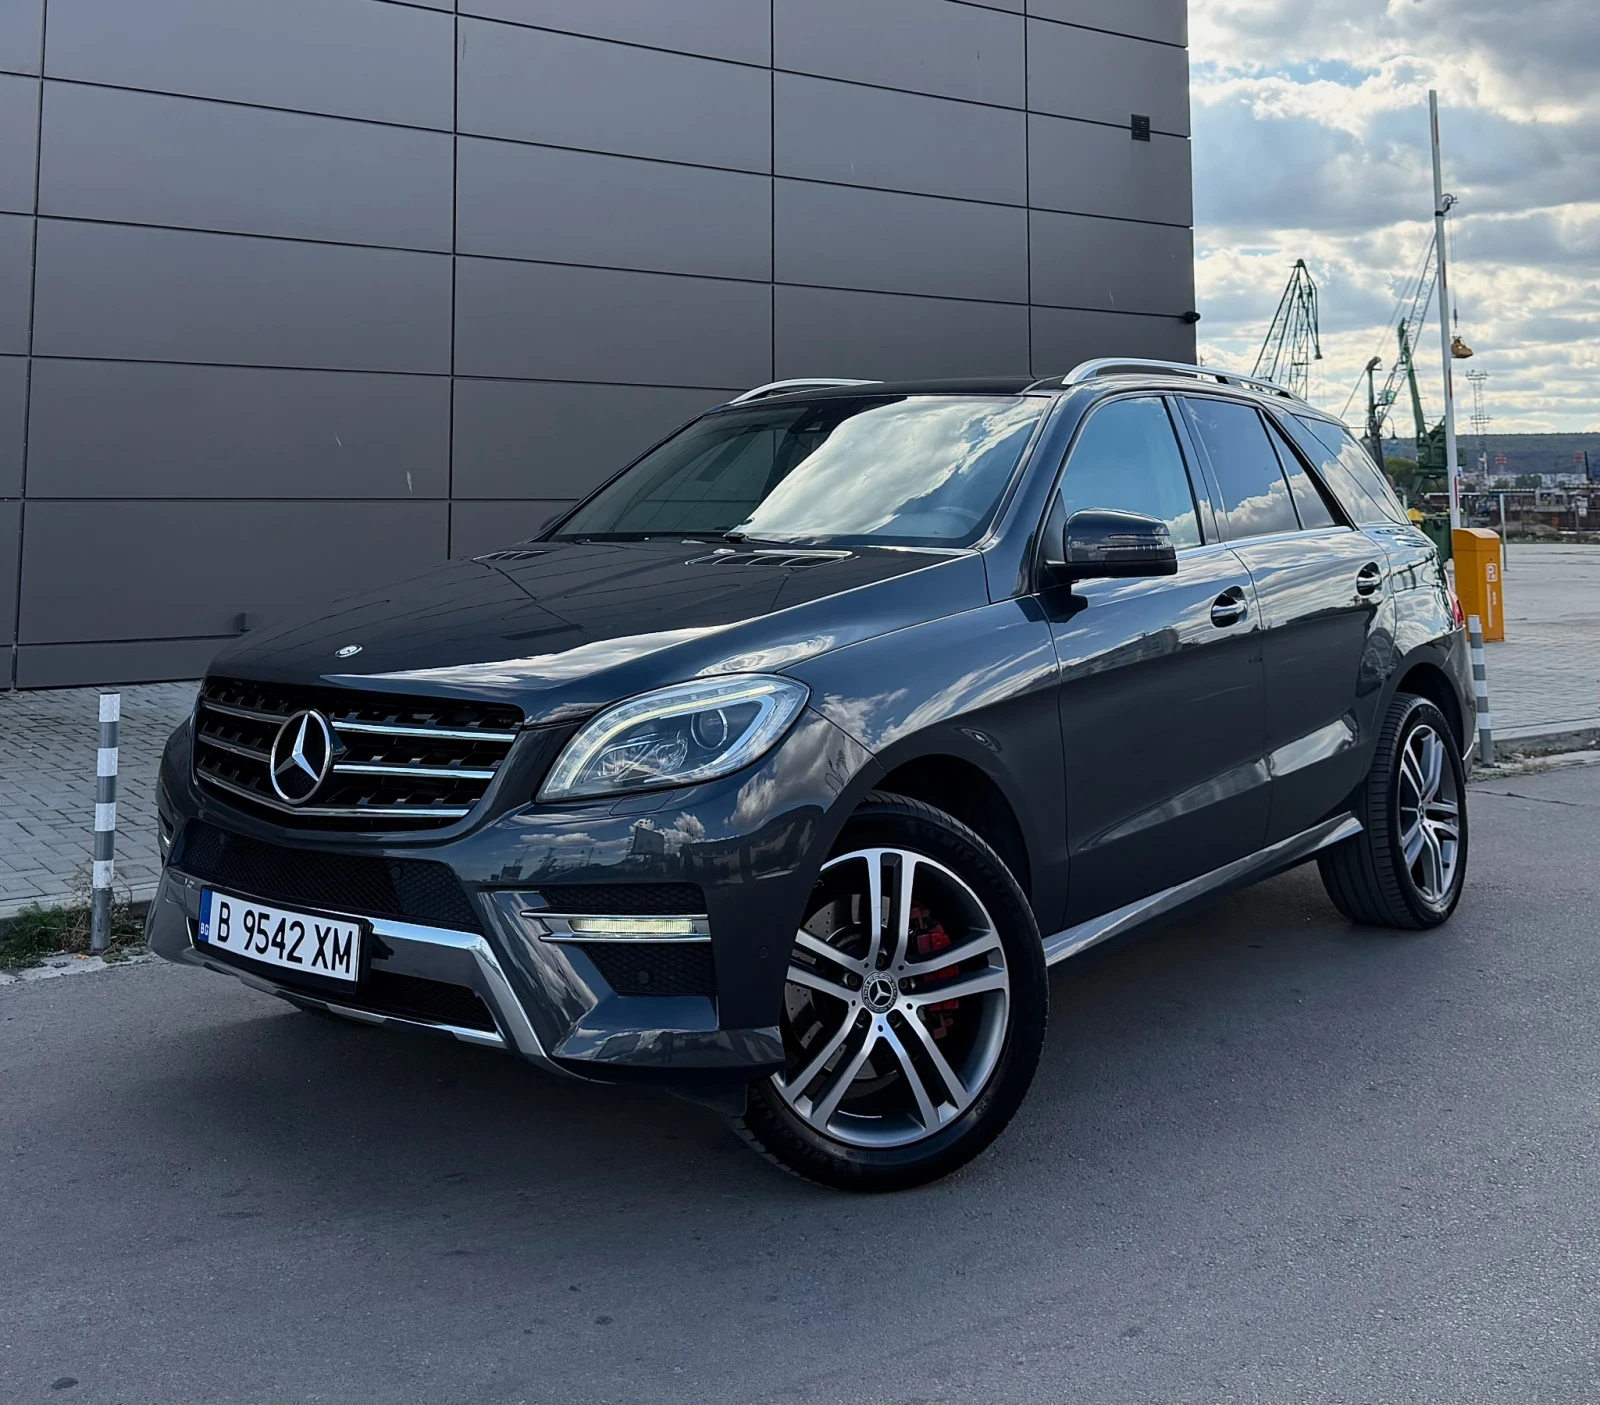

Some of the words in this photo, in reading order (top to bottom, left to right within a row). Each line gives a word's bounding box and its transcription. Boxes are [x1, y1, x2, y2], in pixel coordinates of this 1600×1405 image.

[200, 922, 209, 936] BG
[217, 901, 231, 943] B
[243, 909, 305, 964] 9542
[311, 924, 353, 974] XM
